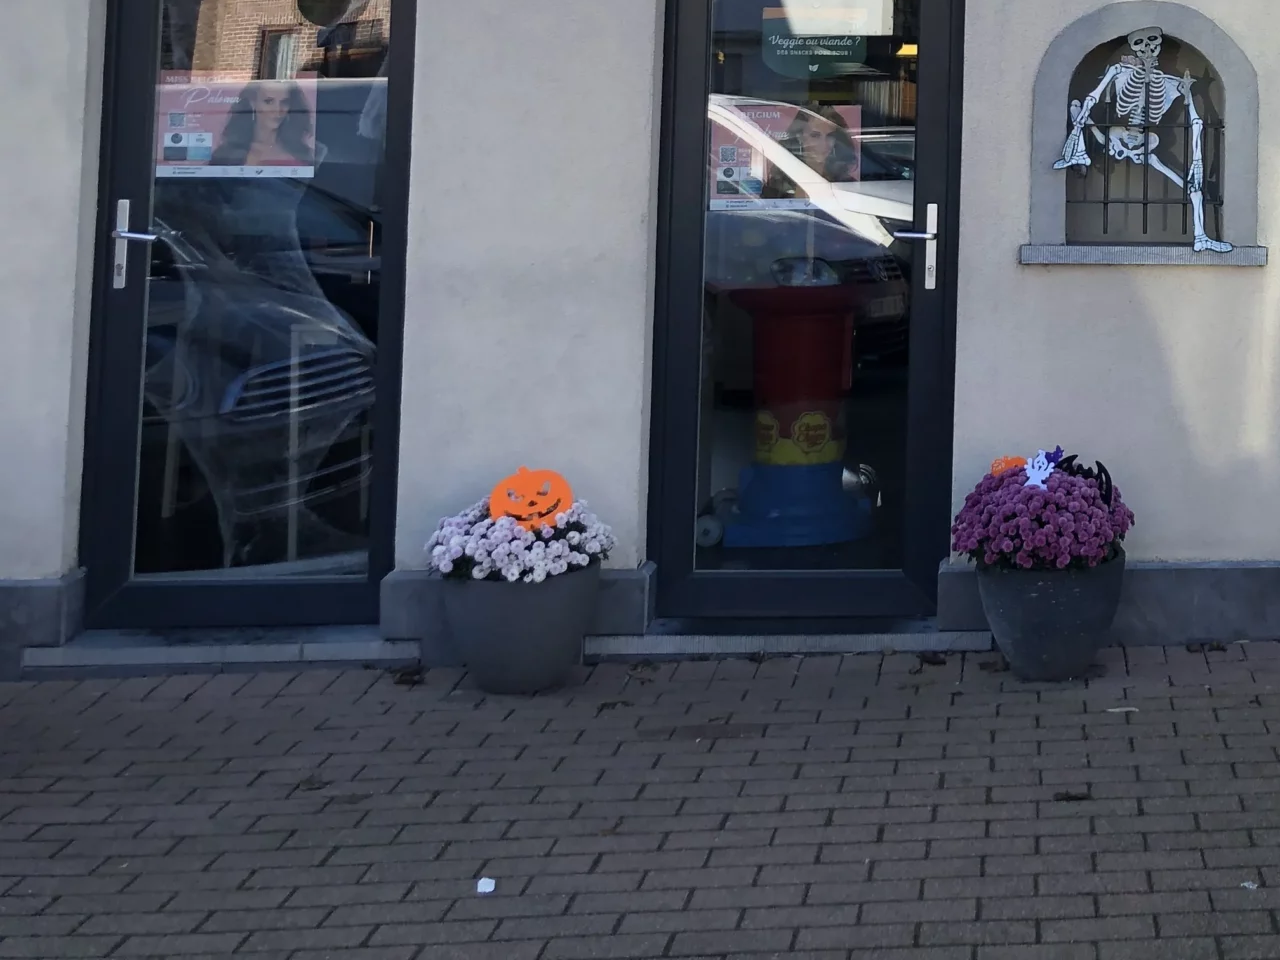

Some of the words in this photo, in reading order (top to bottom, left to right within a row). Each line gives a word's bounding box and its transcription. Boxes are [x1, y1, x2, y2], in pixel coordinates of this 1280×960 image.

[768, 35, 805, 49] Veggie
[805, 38, 818, 46] ou
[819, 36, 853, 46] viande
